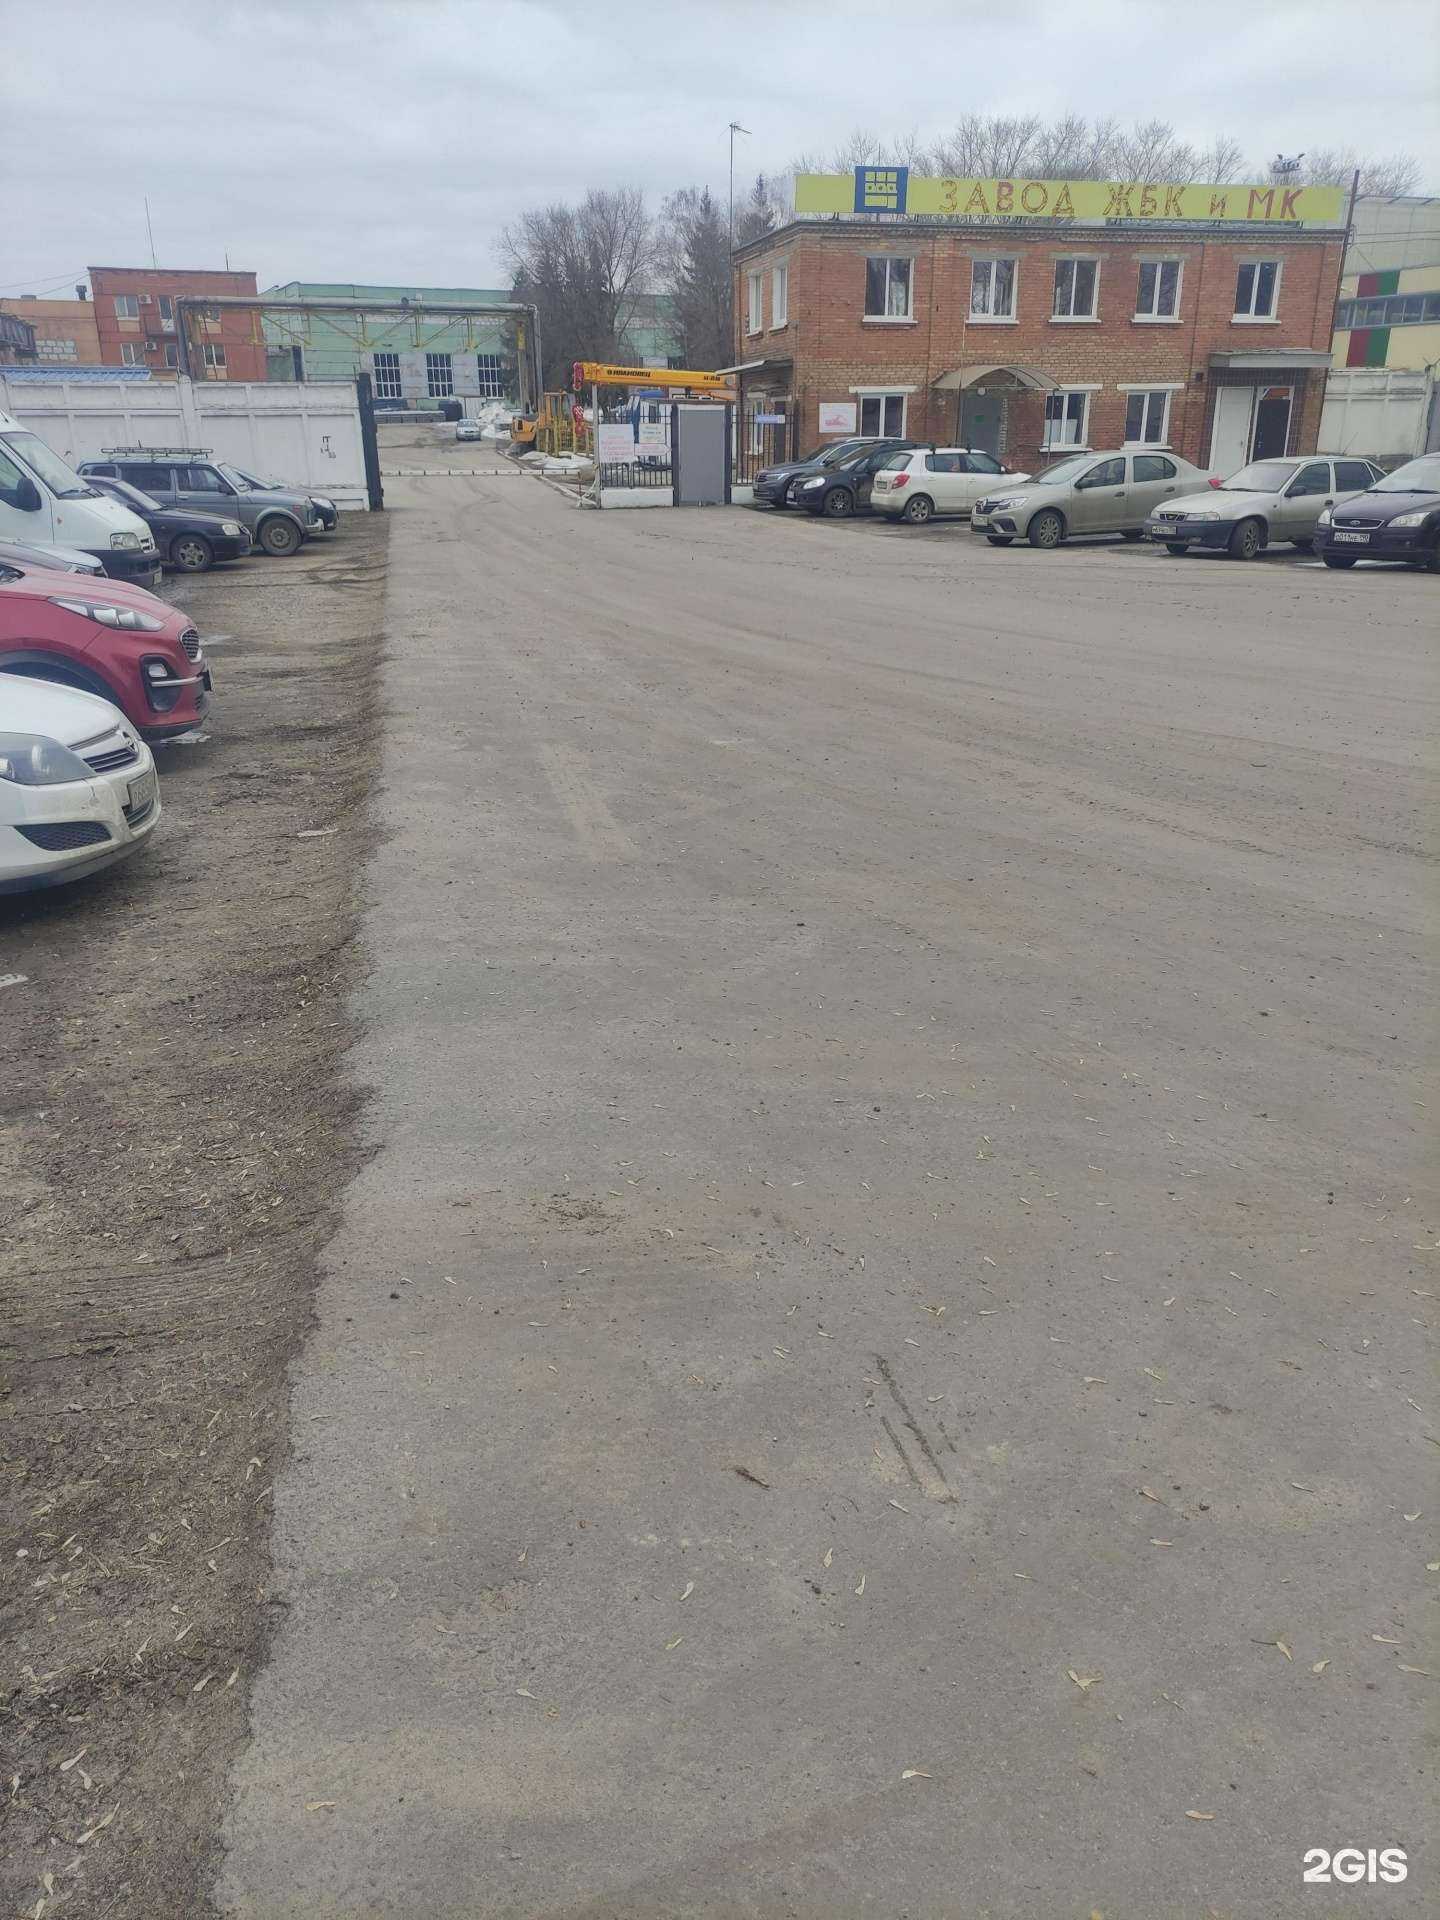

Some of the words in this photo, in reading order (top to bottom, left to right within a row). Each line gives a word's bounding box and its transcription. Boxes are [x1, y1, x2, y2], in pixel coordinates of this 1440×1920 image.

[939, 180, 1075, 218] ЗАВОД
[1102, 184, 1186, 217] ЖБК
[1247, 188, 1303, 219] МК
